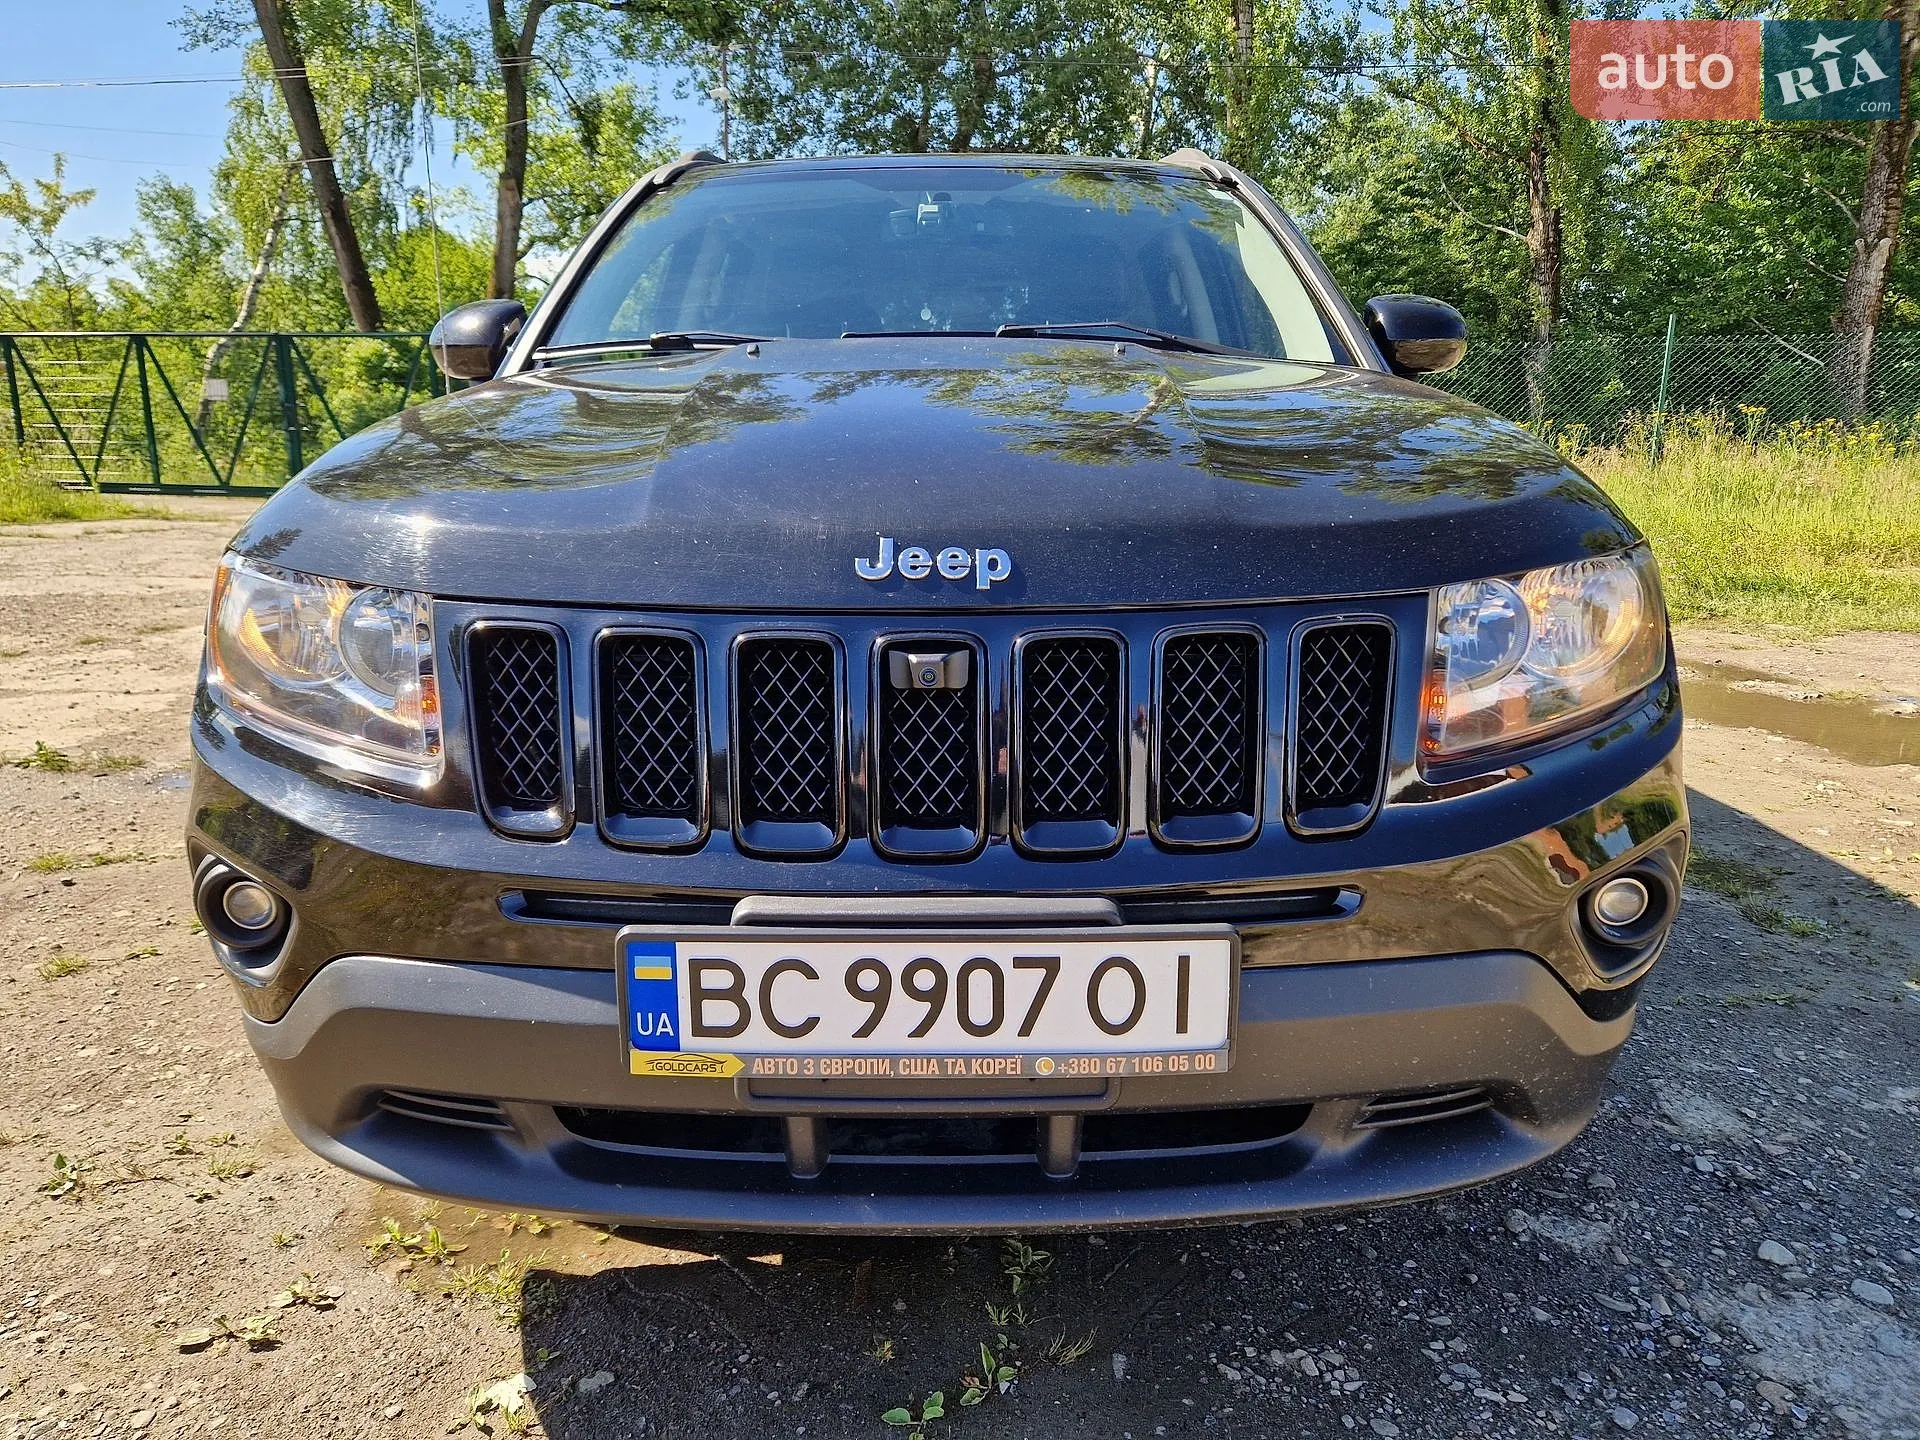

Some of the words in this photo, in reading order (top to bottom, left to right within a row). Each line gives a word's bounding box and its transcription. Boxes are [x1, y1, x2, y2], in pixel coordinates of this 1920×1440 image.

[855, 537, 1012, 590] Jeep
[688, 958, 821, 1038] BC
[844, 957, 1061, 1038] 9907
[636, 1012, 674, 1036] UA
[655, 1061, 717, 1073] GOLDCARS
[752, 1058, 798, 1075] АВТО
[820, 1058, 895, 1077] ЄВРОПИ,
[899, 1058, 939, 1075] США
[943, 1058, 967, 1075] ТА
[971, 1055, 1023, 1075] КОРЕЇ
[1058, 1057, 1100, 1075] +380
[1106, 1057, 1126, 1073] 67
[1131, 1056, 1163, 1073] 106
[1168, 1054, 1189, 1072] 05
[1194, 1053, 1216, 1070] 00
